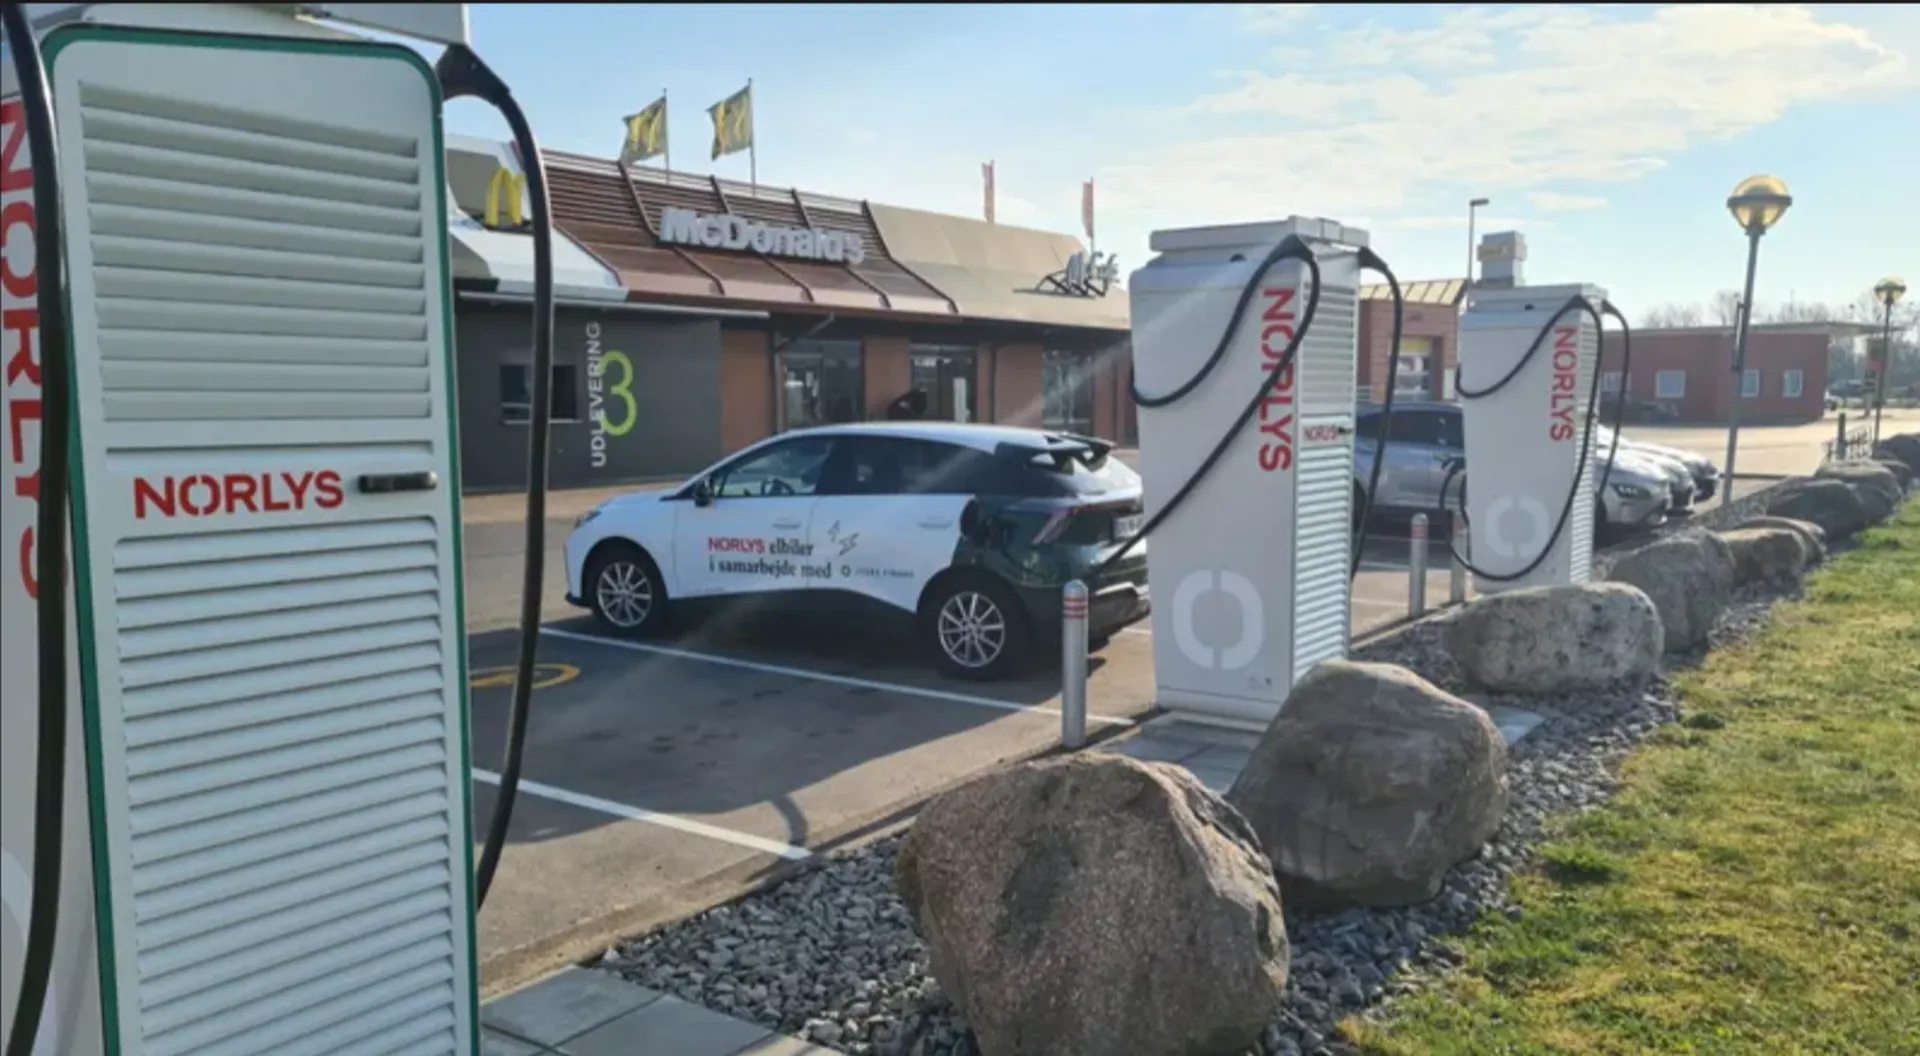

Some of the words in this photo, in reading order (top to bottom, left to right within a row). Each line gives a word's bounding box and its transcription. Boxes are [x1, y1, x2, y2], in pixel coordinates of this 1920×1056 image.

[659, 206, 865, 265] McDonald's
[586, 321, 607, 468] UDLEVERING
[599, 350, 638, 437] 3
[1258, 286, 1296, 472] NORLYS
[1550, 326, 1578, 441] NORLYS
[134, 470, 344, 519] NORLYS
[708, 537, 765, 553] NORLYS
[769, 537, 814, 556] elbiler
[718, 557, 797, 579] samarbejde
[801, 560, 831, 578] med
